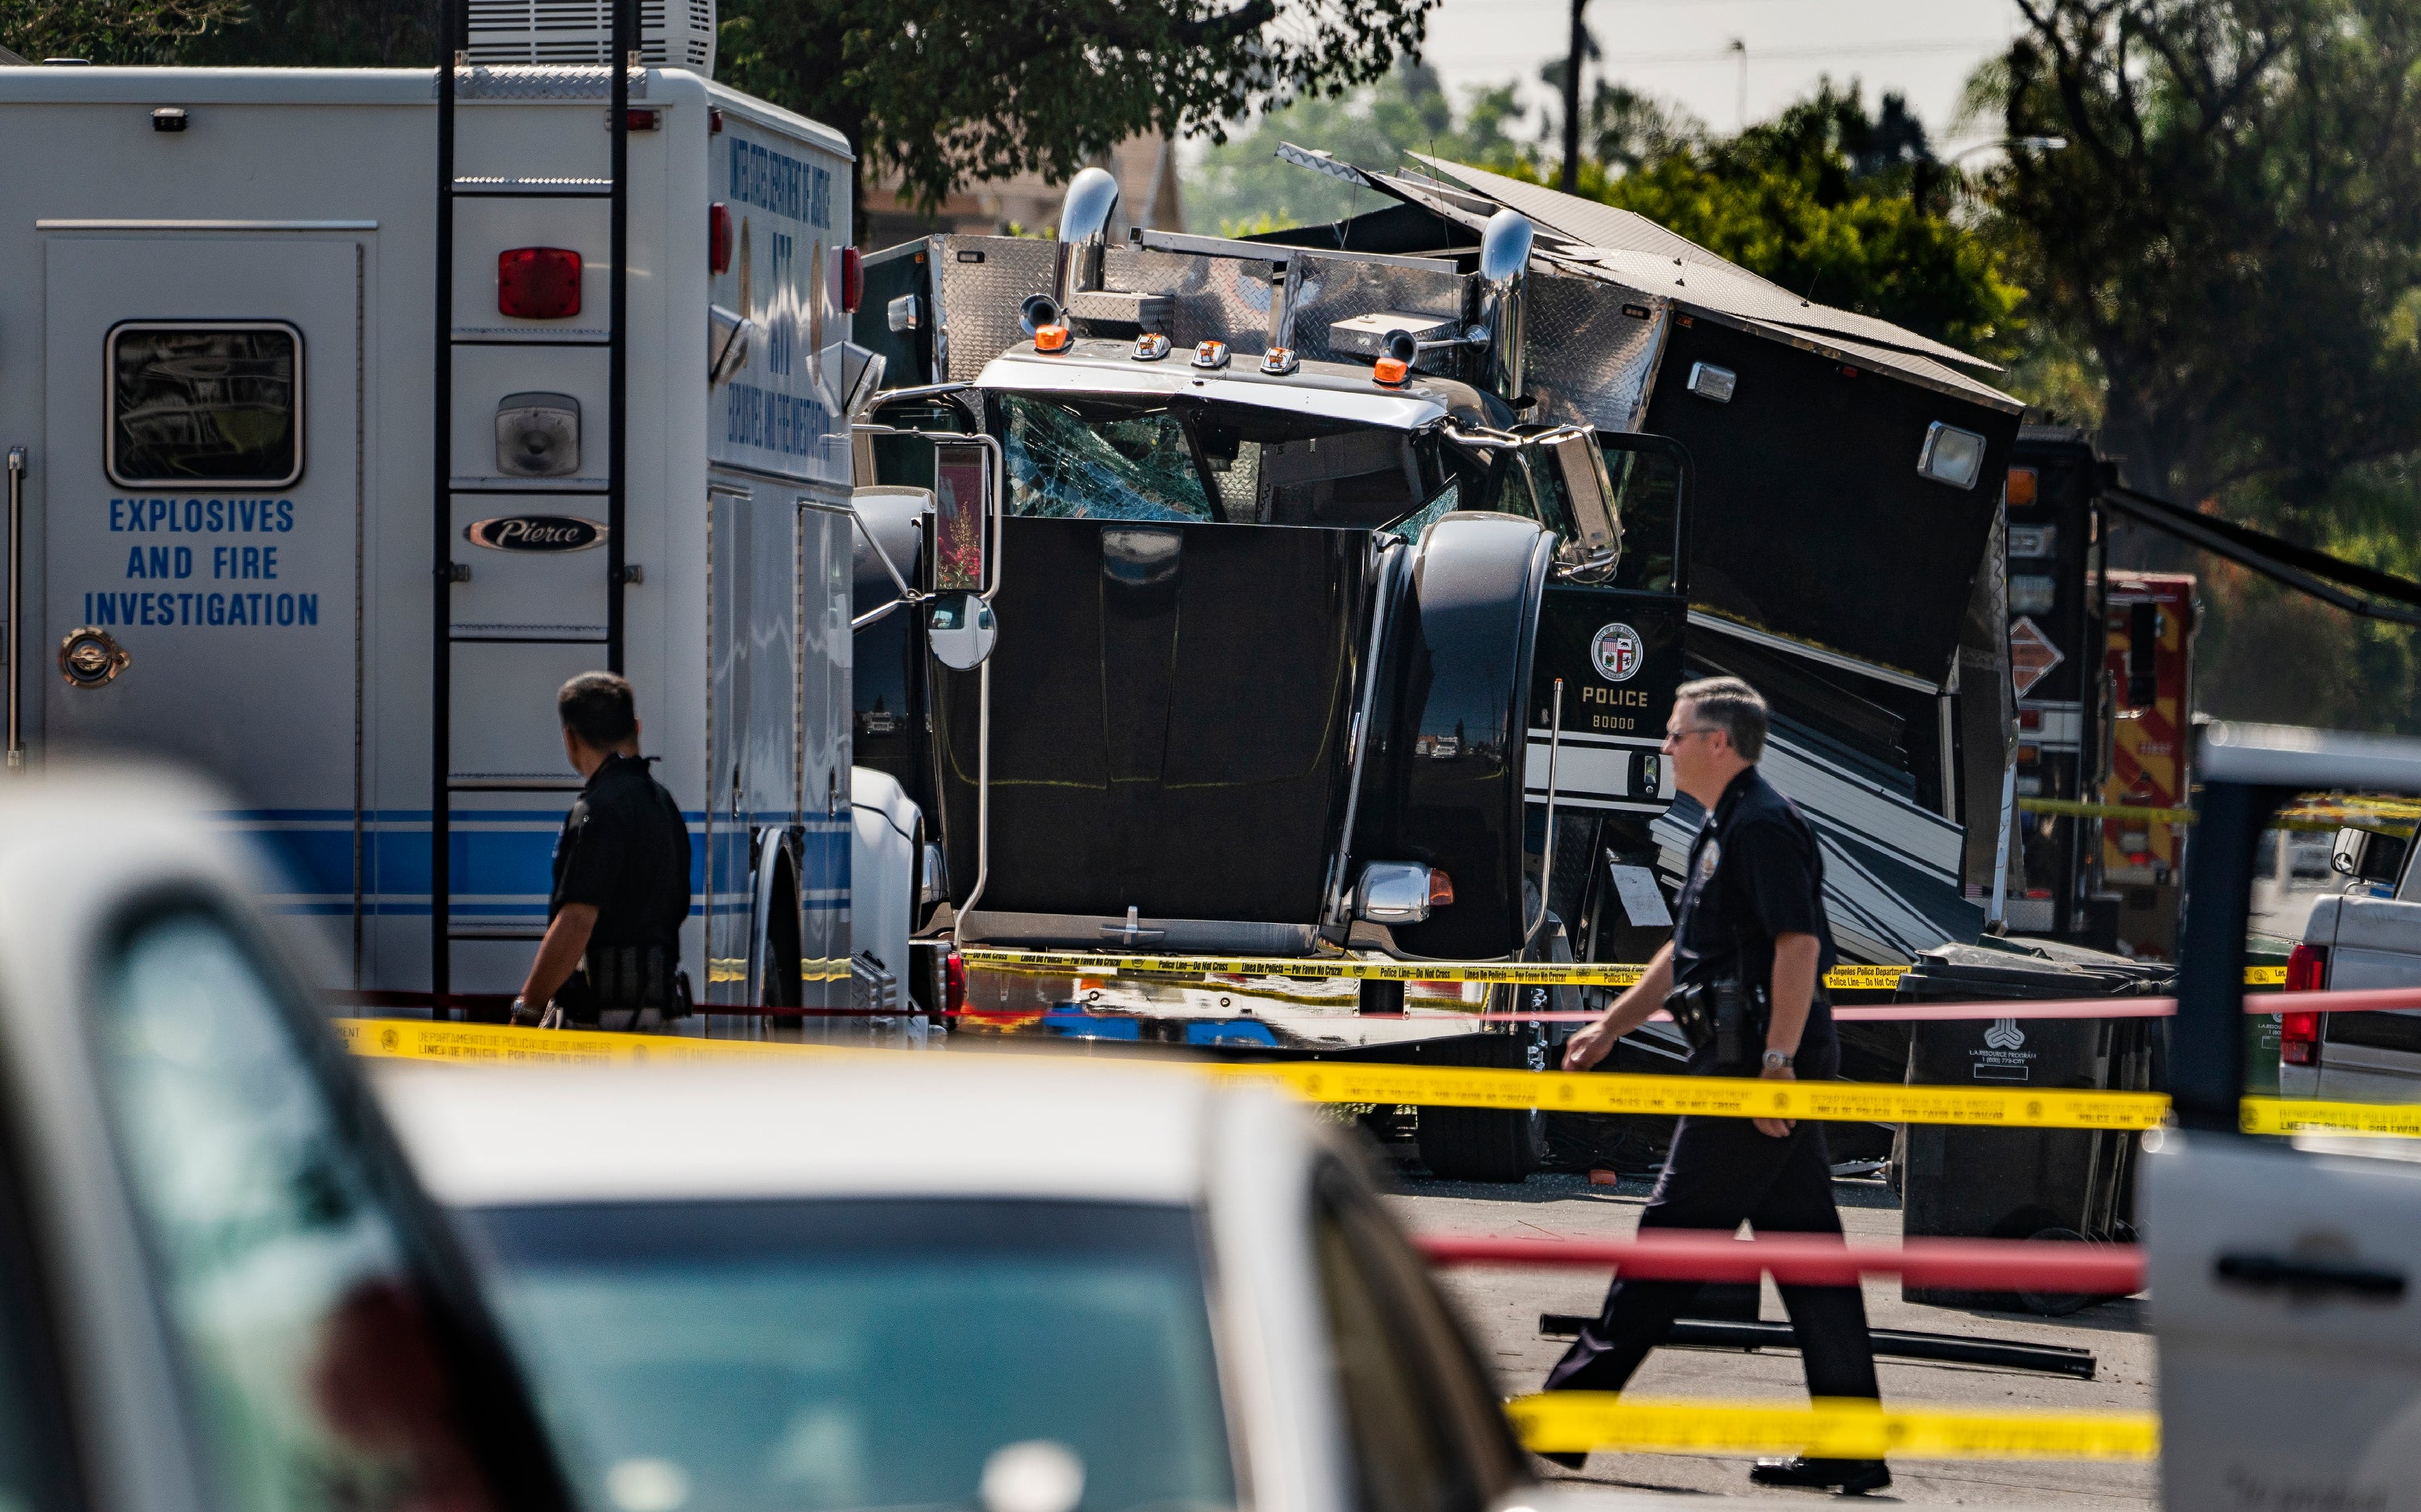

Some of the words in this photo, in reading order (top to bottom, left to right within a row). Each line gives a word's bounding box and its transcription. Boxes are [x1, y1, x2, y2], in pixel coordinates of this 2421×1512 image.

[110, 499, 294, 533] EXPLOSIVES
[496, 520, 579, 546] Pierce
[126, 546, 192, 579] AND
[214, 547, 278, 579] FIRE
[85, 592, 317, 626] INVESTIGATION
[1583, 687, 1648, 707] POLICE
[1593, 715, 1634, 729] 80000
[1158, 960, 1175, 969] Police
[1202, 961, 1211, 970] Not
[1212, 962, 1228, 971] Cross
[1242, 963, 1256, 972] Linea
[1256, 963, 1264, 972] De
[1265, 963, 1283, 973] Policia
[1292, 965, 1301, 974] Por
[1302, 965, 1316, 974] Favor
[1317, 966, 1324, 975] No
[1325, 966, 1343, 975] Cruzar
[1834, 967, 1855, 976] Angeles
[1857, 967, 1874, 975] Police
[1875, 967, 1908, 976] Department
[1381, 968, 1397, 977] Police
[1424, 969, 1435, 979] Not
[1436, 969, 1450, 979] Cross
[1465, 970, 1479, 980] Linea
[1480, 971, 1487, 980] De
[1488, 971, 1507, 981] Policia
[1516, 971, 1524, 981] Por
[1525, 972, 1540, 982] Favor
[1541, 972, 1548, 982] No
[1549, 972, 1566, 982] Cruzar
[1604, 973, 1620, 983] Police
[1829, 977, 1846, 986] Police
[1875, 978, 1884, 986] Not
[1885, 978, 1898, 986] Cros
